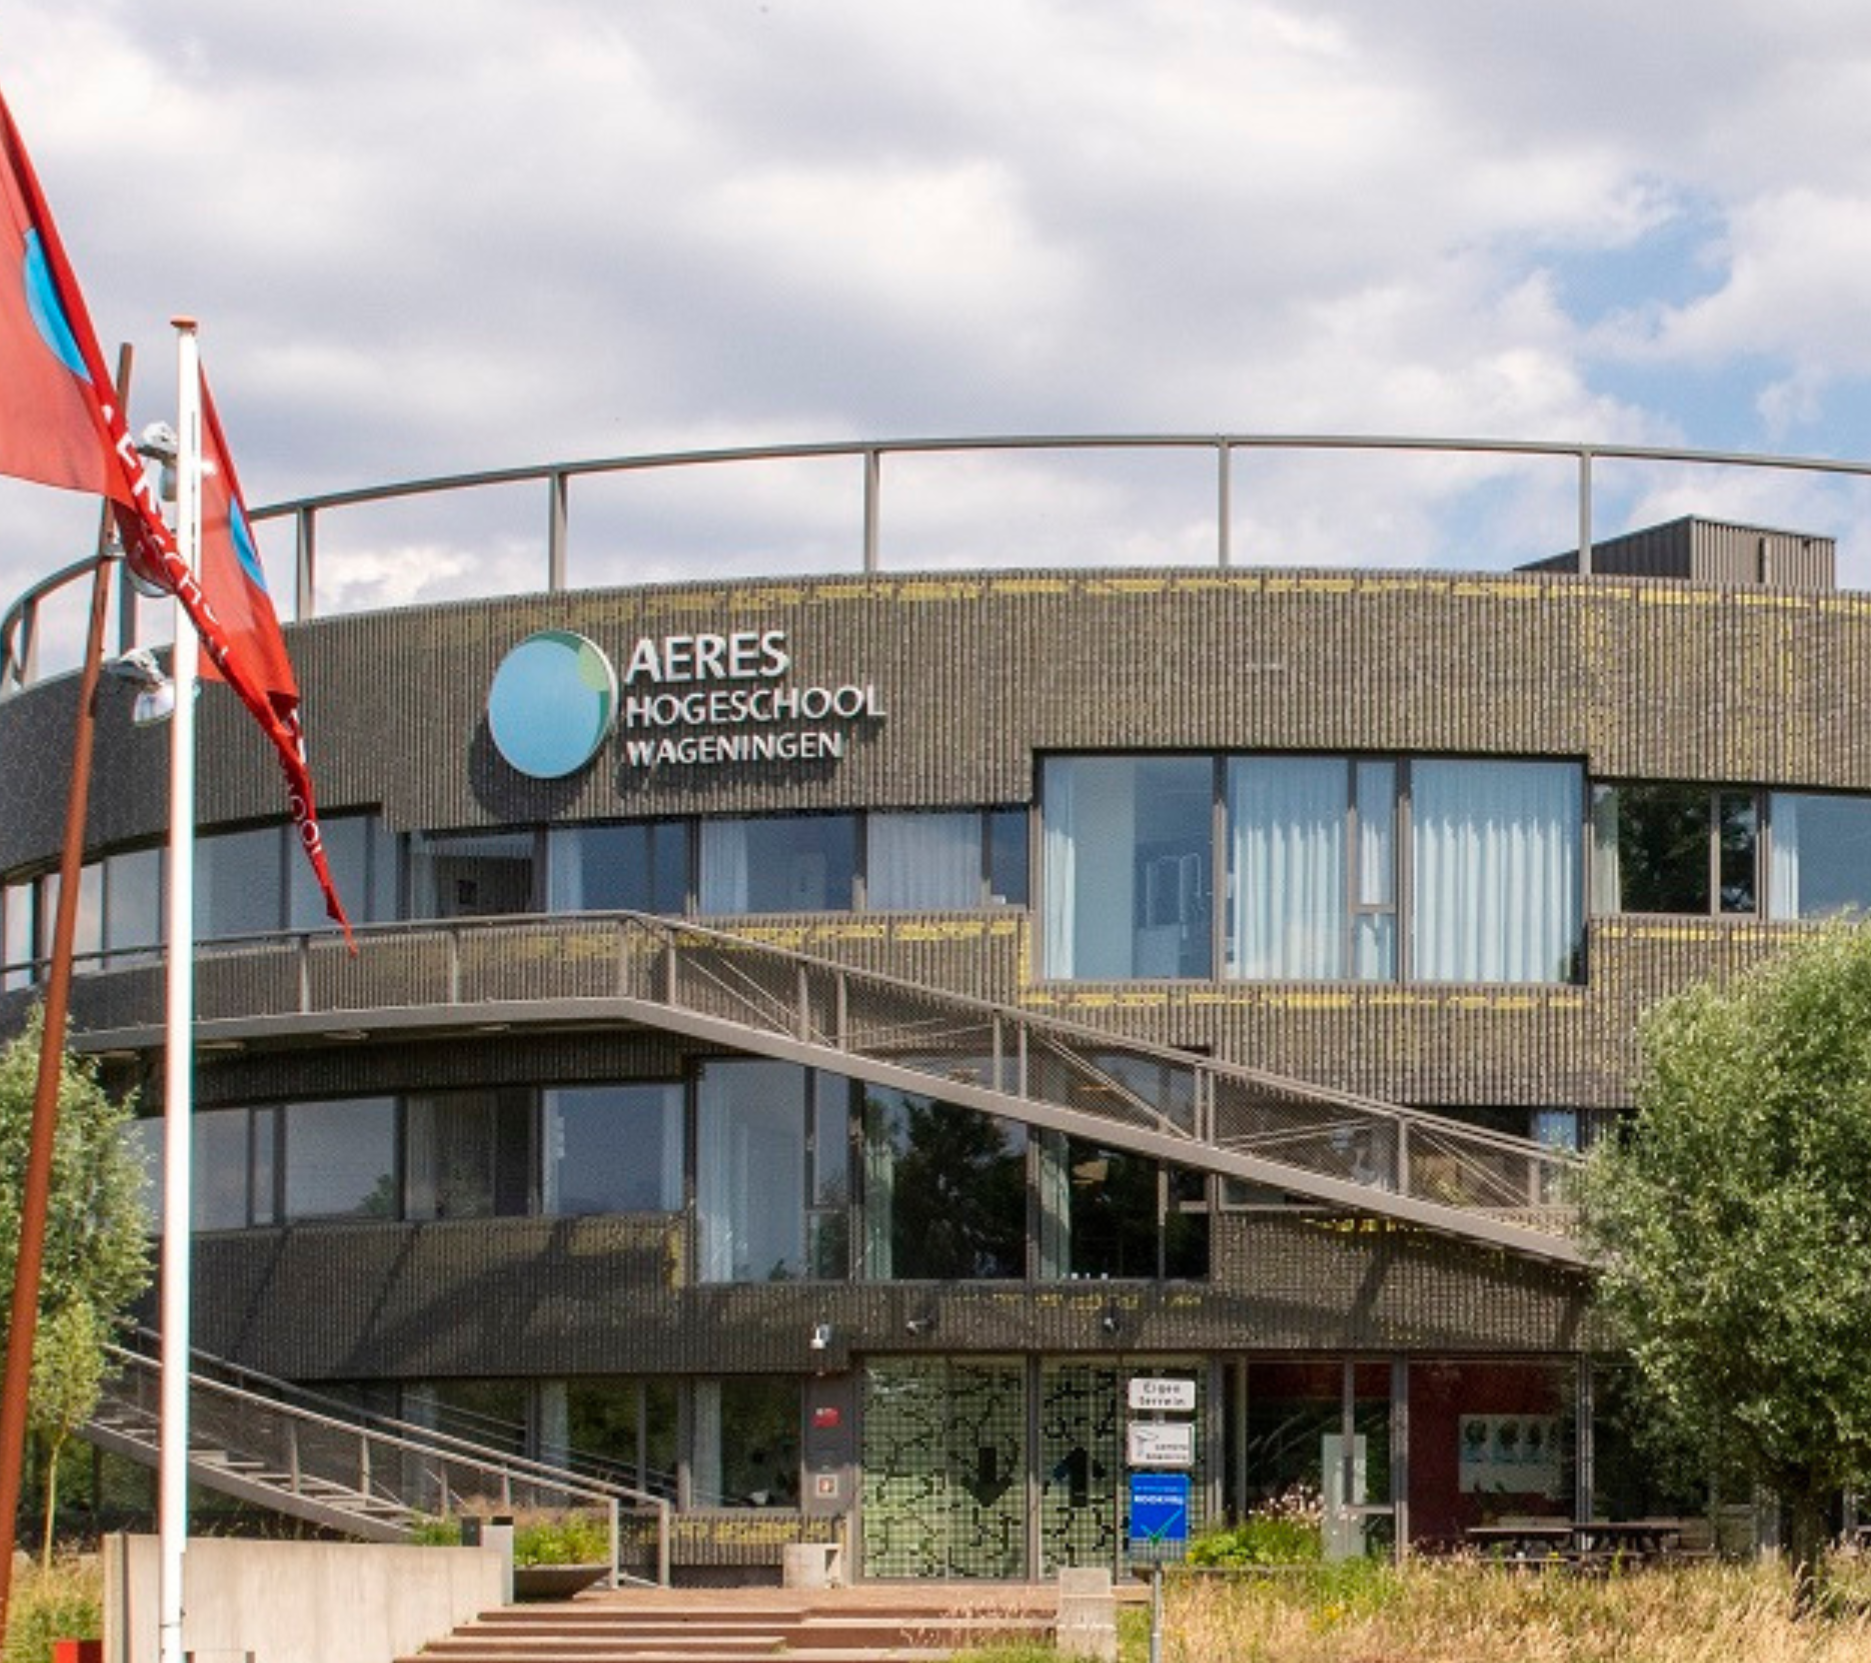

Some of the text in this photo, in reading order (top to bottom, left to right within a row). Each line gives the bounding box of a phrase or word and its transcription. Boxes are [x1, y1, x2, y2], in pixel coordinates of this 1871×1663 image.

[624, 630, 791, 684] AERES
[626, 684, 887, 729] HOGESCHOOL
[626, 731, 844, 767] WAGENINGEN
[1143, 1382, 1181, 1395] Eigen
